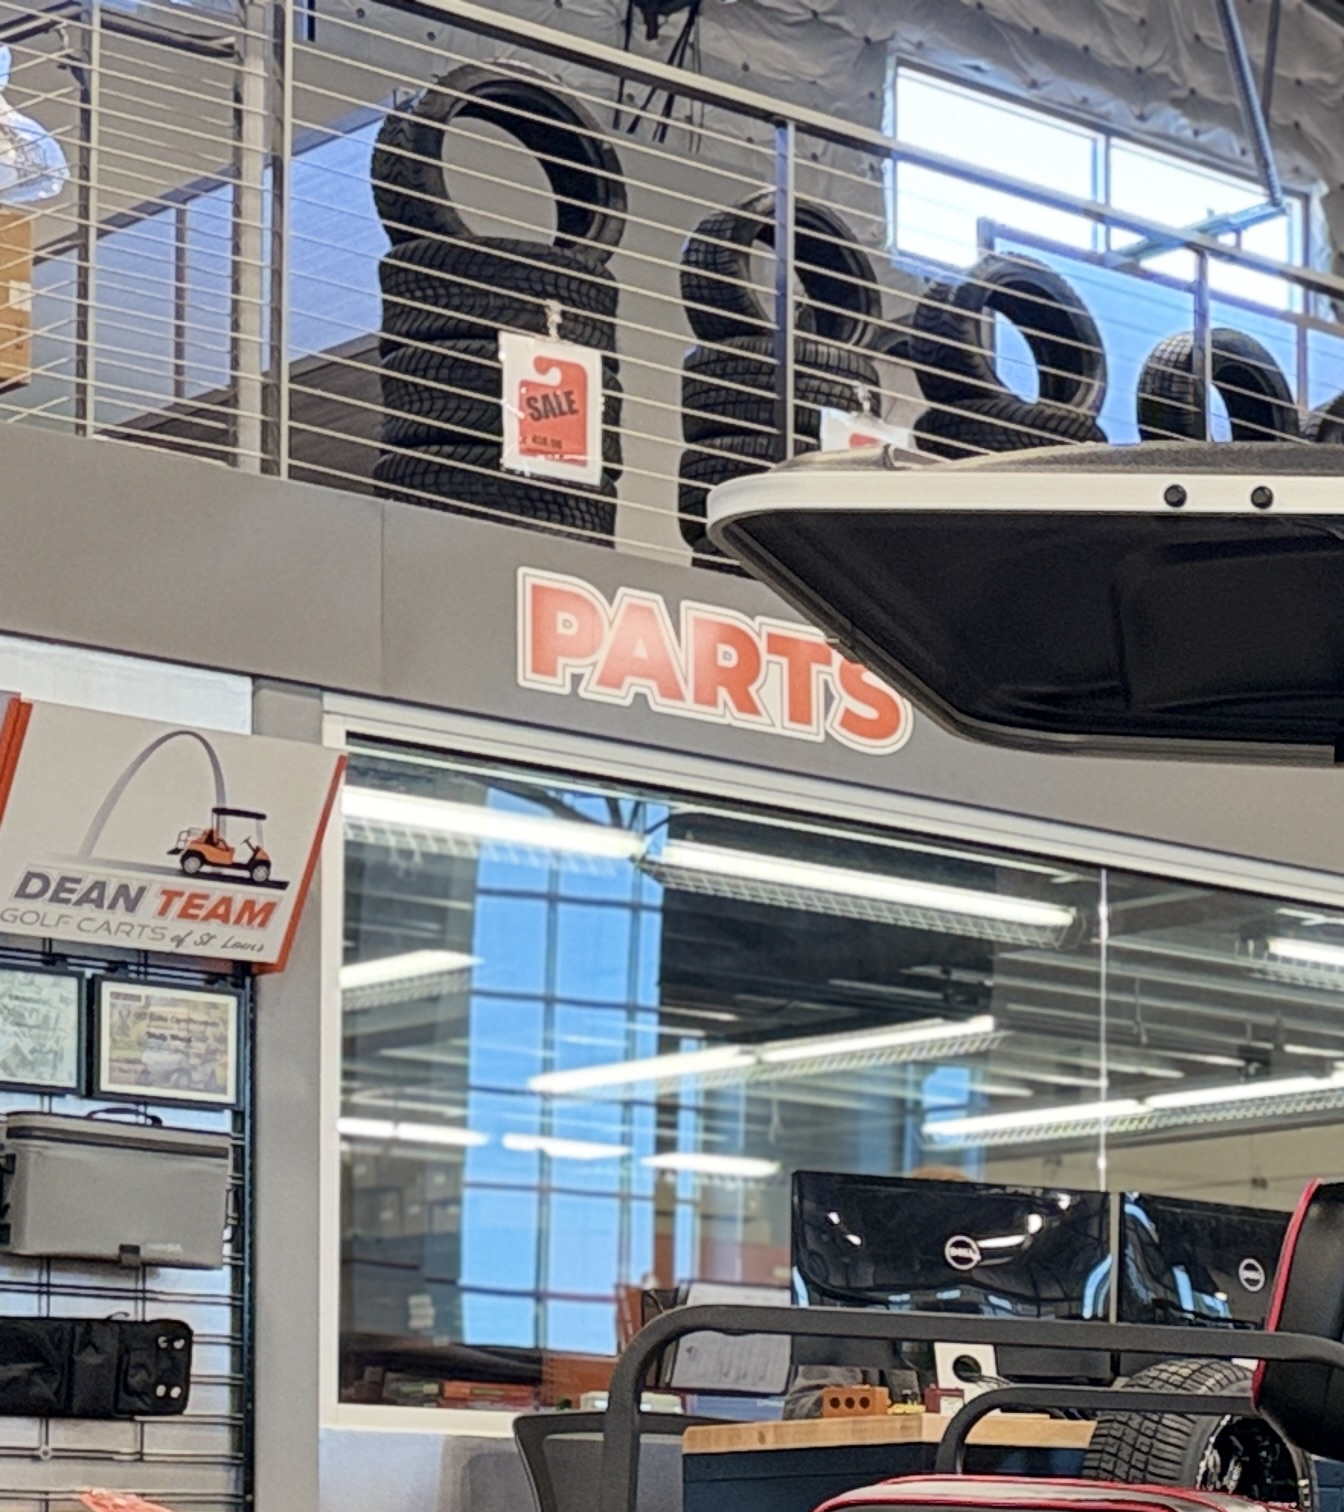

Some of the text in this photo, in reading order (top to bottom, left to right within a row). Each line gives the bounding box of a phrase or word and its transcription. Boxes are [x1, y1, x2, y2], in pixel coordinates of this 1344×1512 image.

[525, 390, 579, 422] SALE
[520, 571, 911, 751] PARTS
[13, 871, 278, 929] DEAN TEAM
[0, 907, 73, 927] GOLF
[77, 917, 168, 942] CARTS
